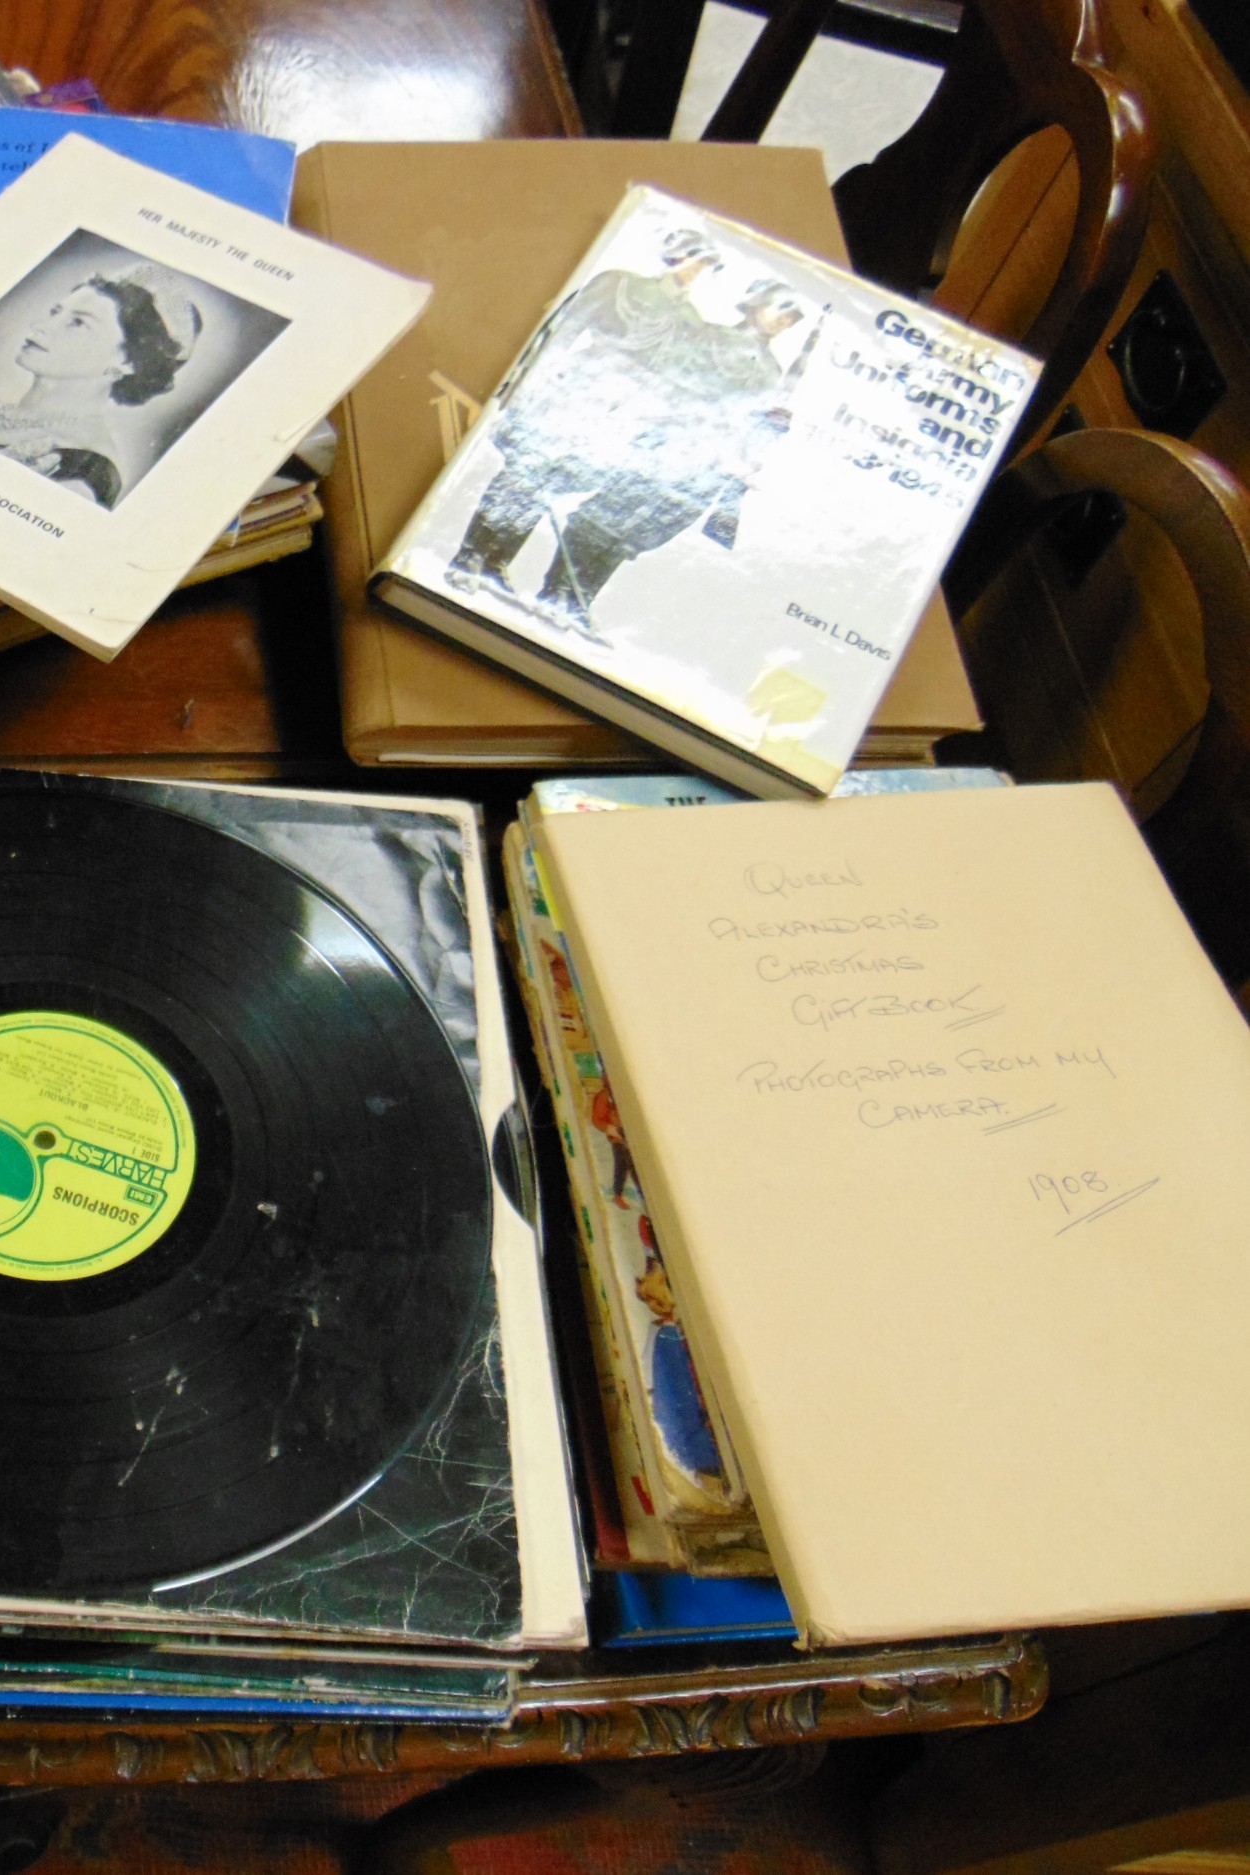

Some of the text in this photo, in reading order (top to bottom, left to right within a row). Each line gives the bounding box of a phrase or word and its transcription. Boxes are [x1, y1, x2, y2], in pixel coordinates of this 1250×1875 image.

[15, 138, 39, 152] of
[137, 207, 294, 282] HER MAJESTY THE QUEEN
[874, 309, 1026, 392] German
[918, 417, 995, 461] and
[785, 602, 892, 661] Brian L Davis
[756, 950, 924, 982] CHRISTMAS
[956, 1048, 1041, 1076] FROM
[1056, 1046, 1118, 1080] MY
[39, 1088, 89, 1112] BLACKOUT
[67, 1139, 167, 1191] HARVEST
[141, 1149, 161, 1163] SIDE
[52, 1186, 140, 1227] SCORPIONS
[1029, 1170, 1108, 1214] 1908
